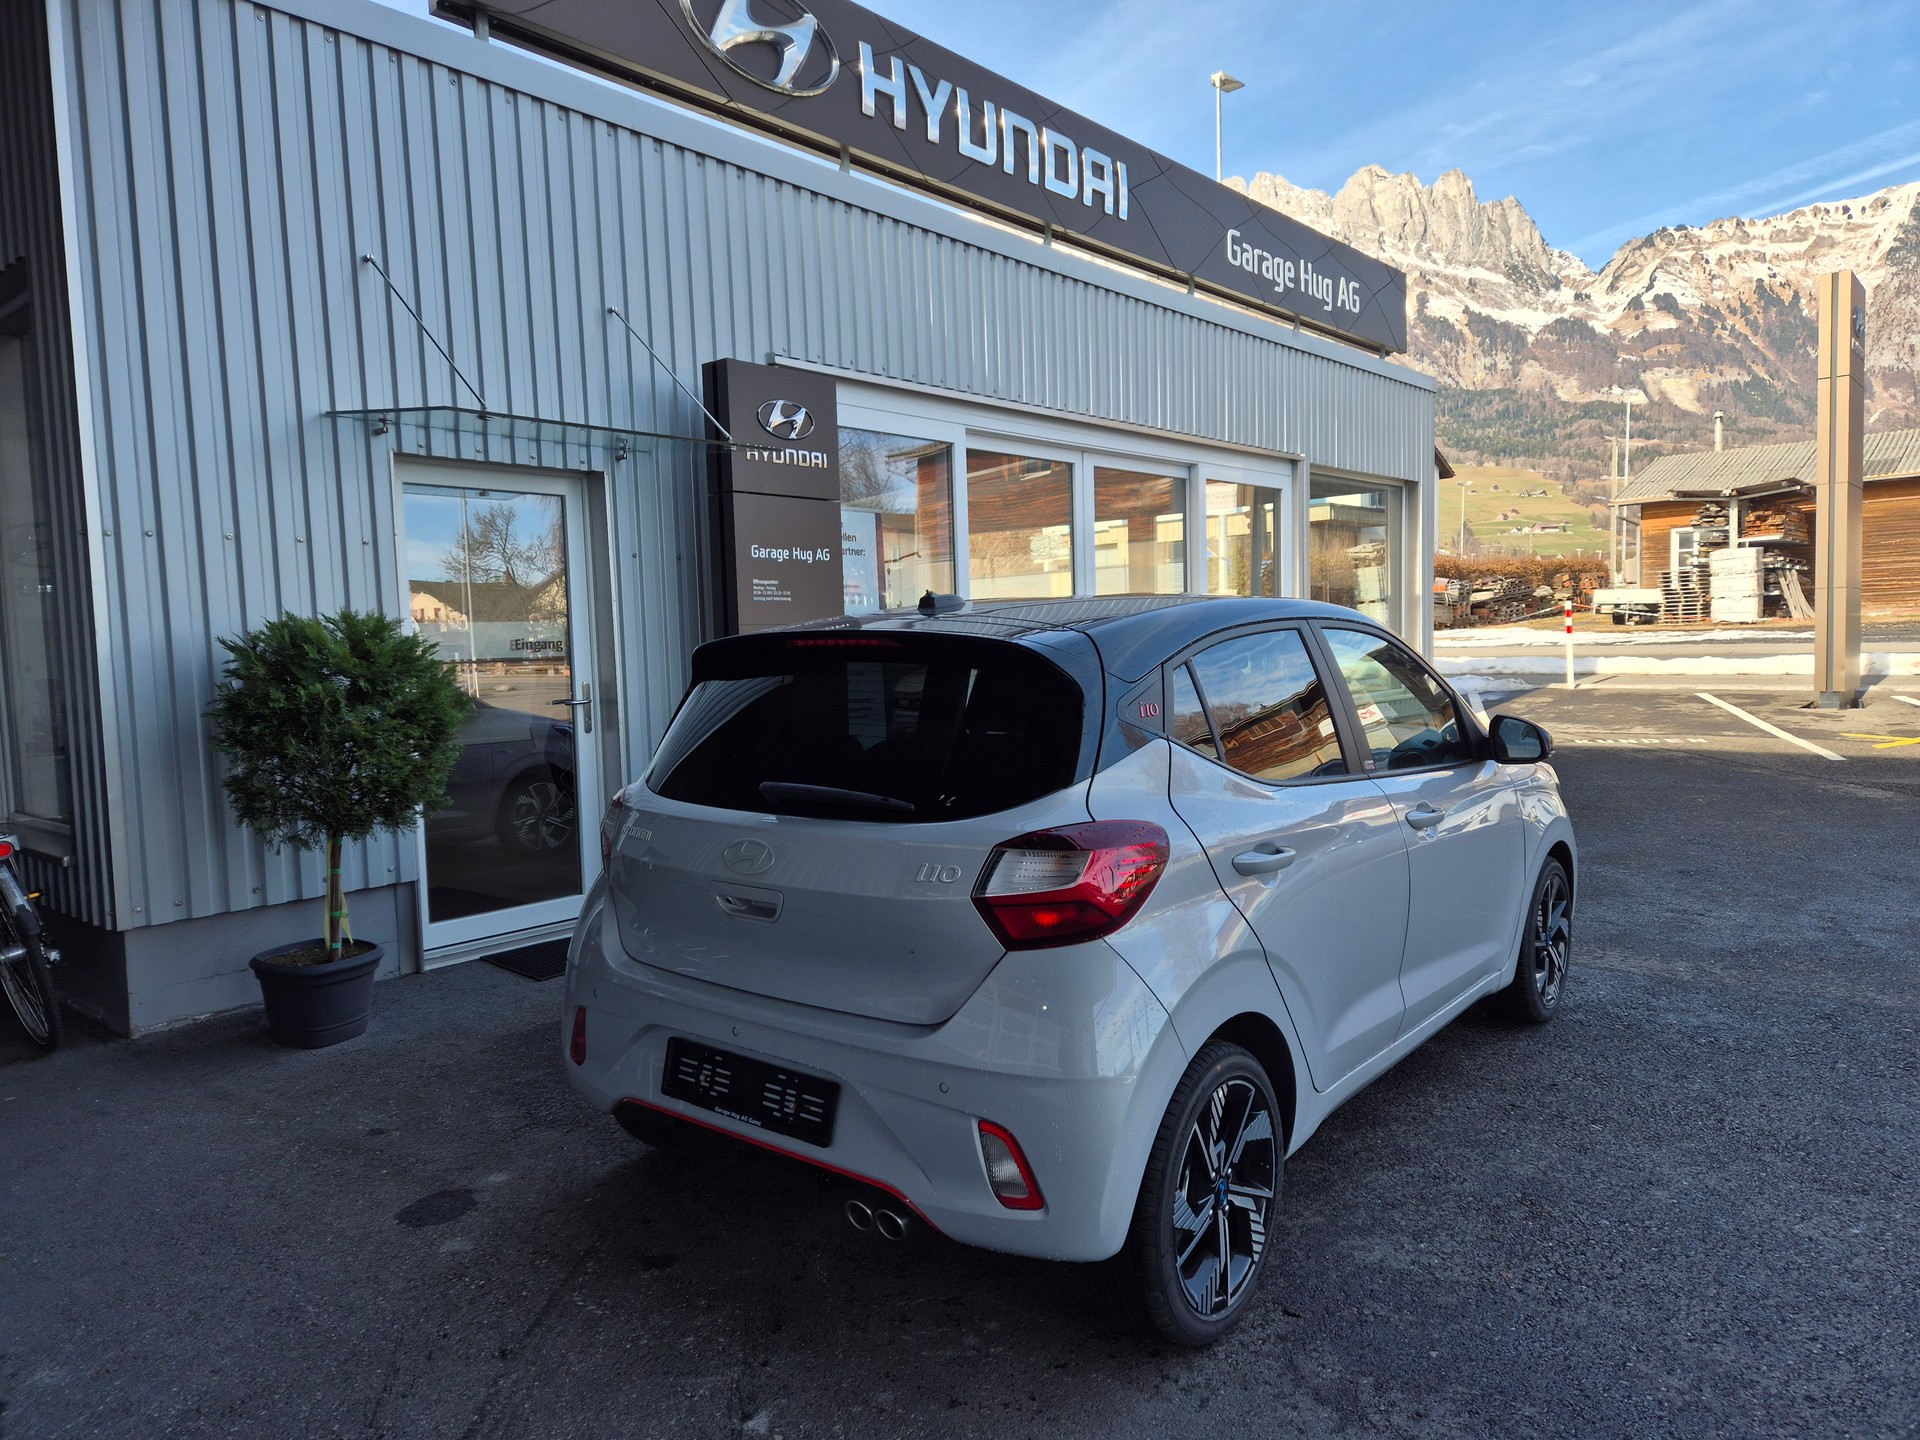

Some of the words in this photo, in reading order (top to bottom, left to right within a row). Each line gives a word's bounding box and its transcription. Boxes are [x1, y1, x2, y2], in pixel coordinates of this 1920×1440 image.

[858, 40, 1128, 221] HYUNDAI
[1227, 228, 1295, 293] Garage
[1300, 259, 1333, 312] Hug
[1337, 276, 1360, 314] AG
[746, 443, 828, 469] HYUNDAI
[751, 544, 790, 562] Garage
[792, 546, 813, 563] Hug
[815, 548, 830, 561] AG
[515, 638, 564, 653] Eingang
